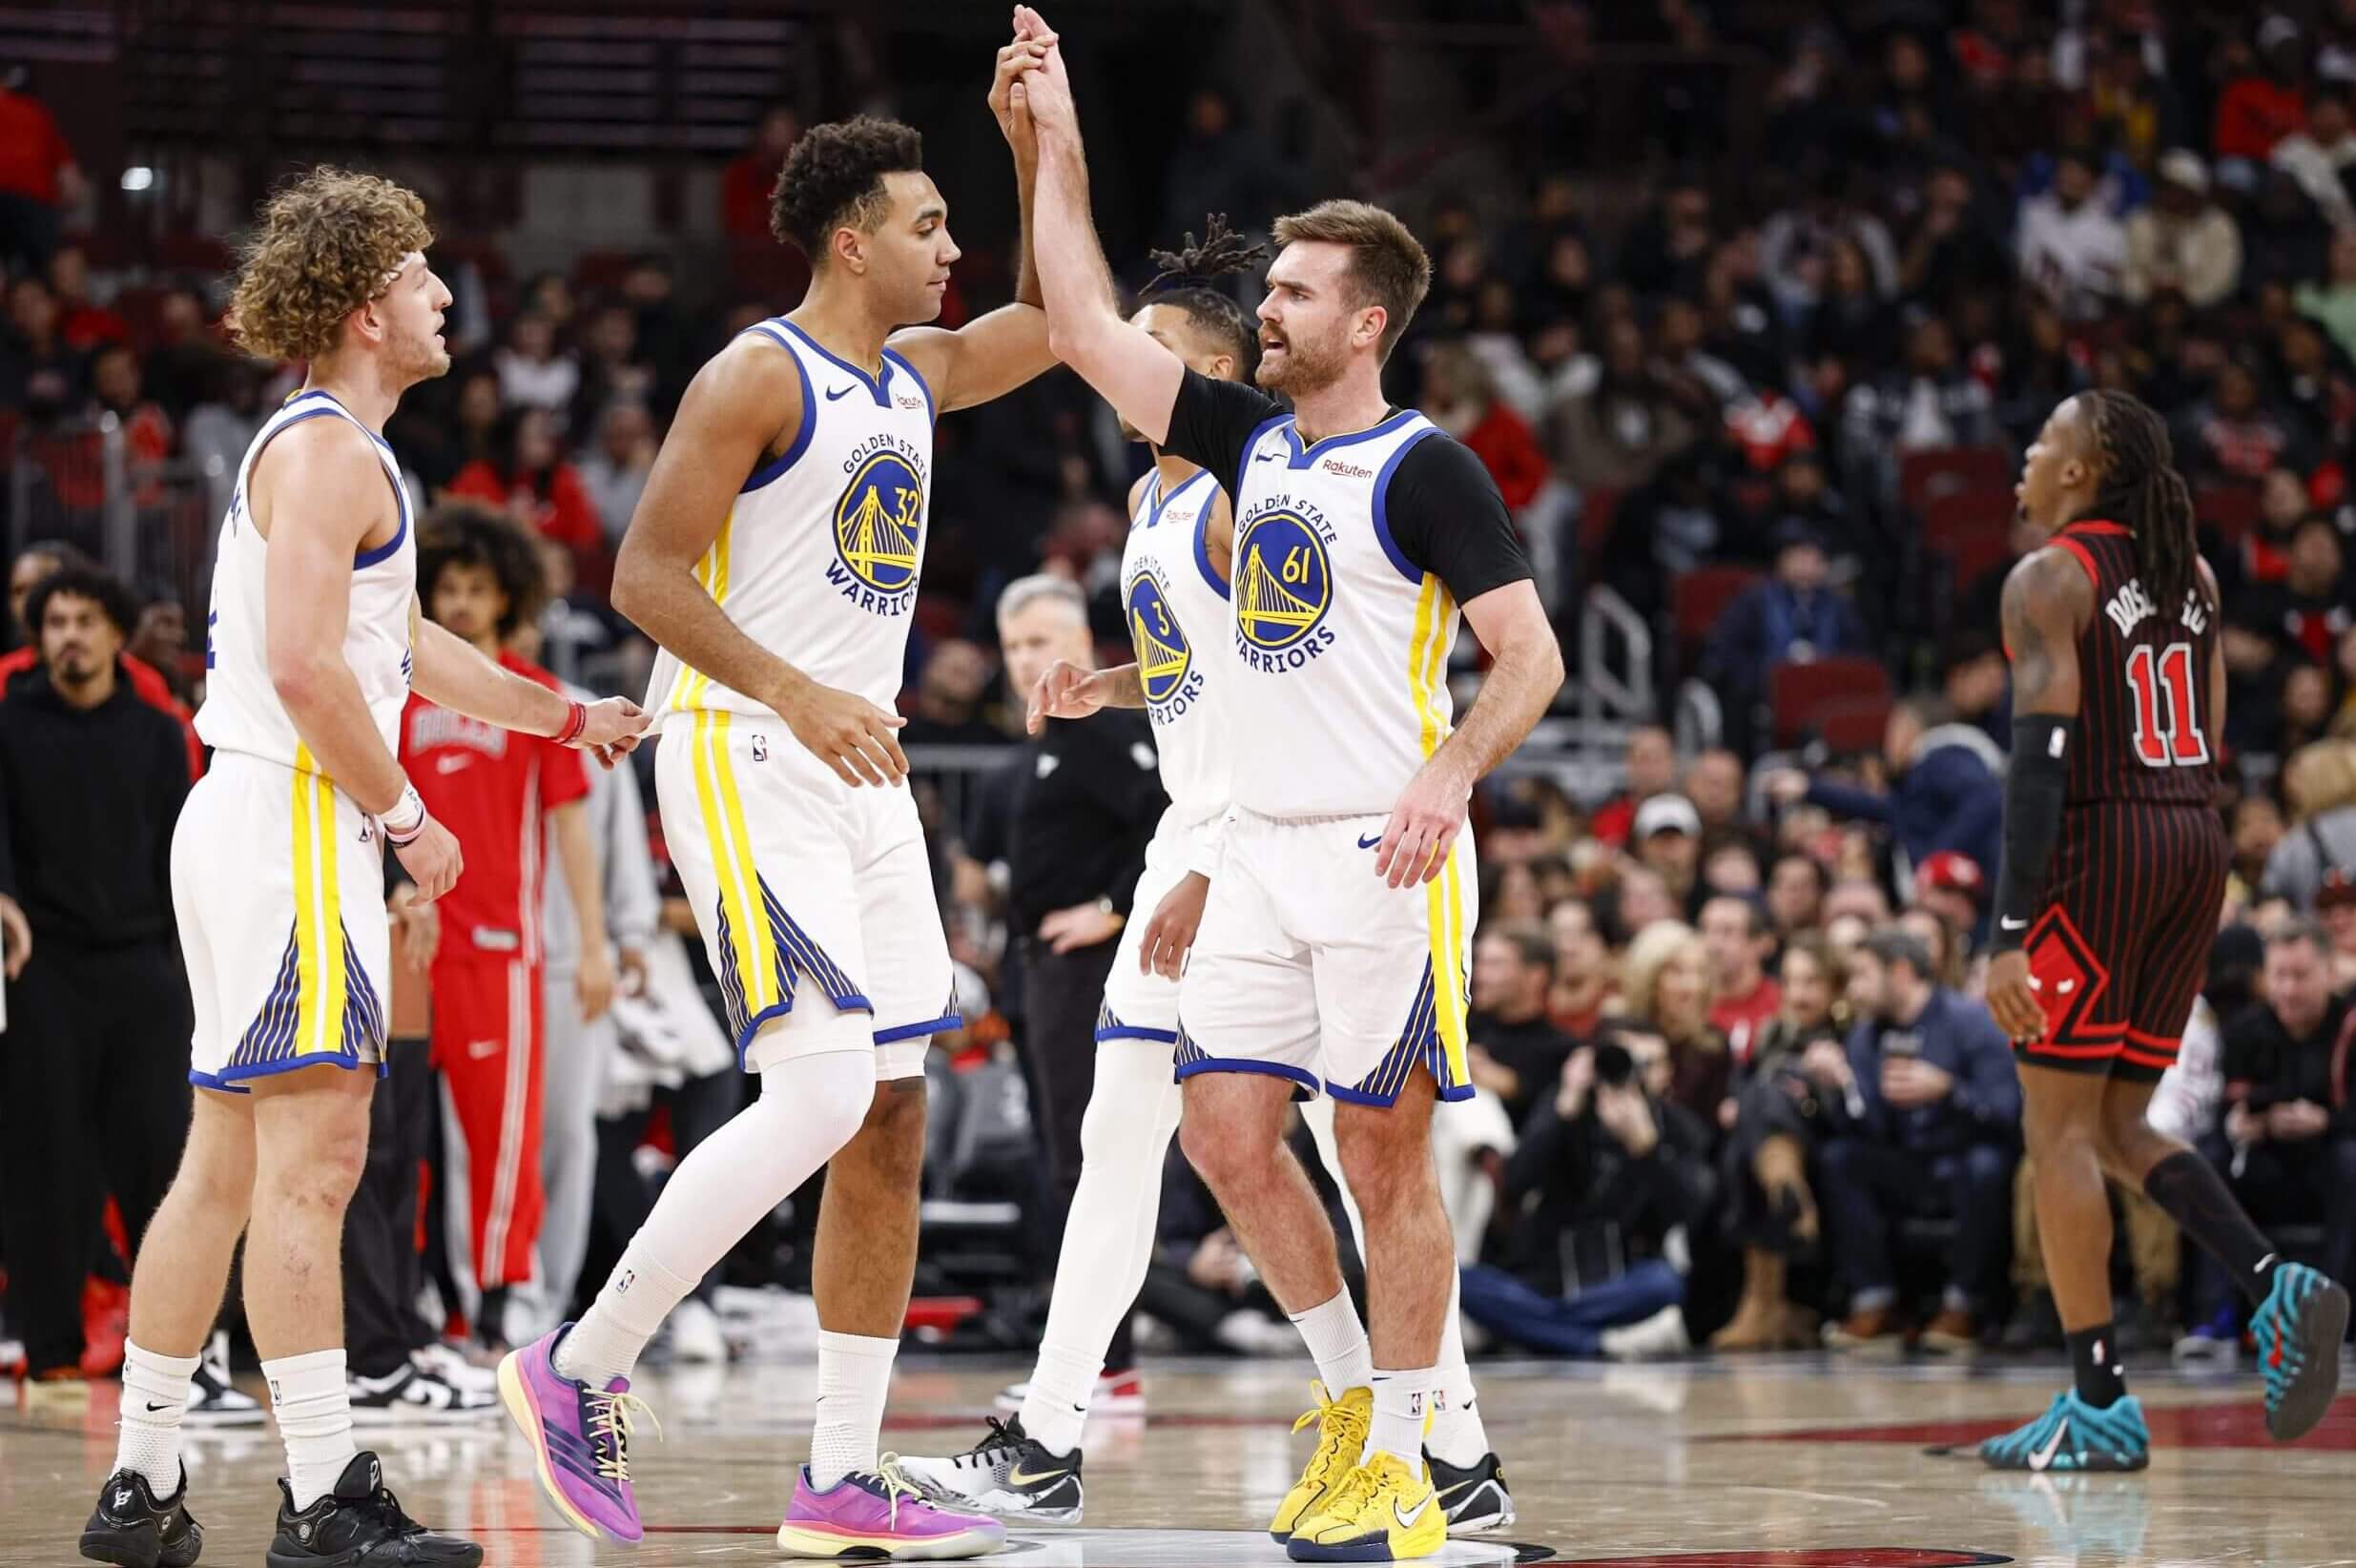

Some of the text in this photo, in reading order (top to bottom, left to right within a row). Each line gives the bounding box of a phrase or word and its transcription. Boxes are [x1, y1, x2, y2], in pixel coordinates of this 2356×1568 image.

[843, 433, 895, 474] GOLDEN
[1322, 459, 1373, 479] Rakuten
[894, 486, 920, 528] 32
[1295, 499, 1337, 545] STATE
[1281, 545, 1312, 585] 61
[1150, 600, 1170, 637] 3
[2125, 642, 2210, 767] 11
